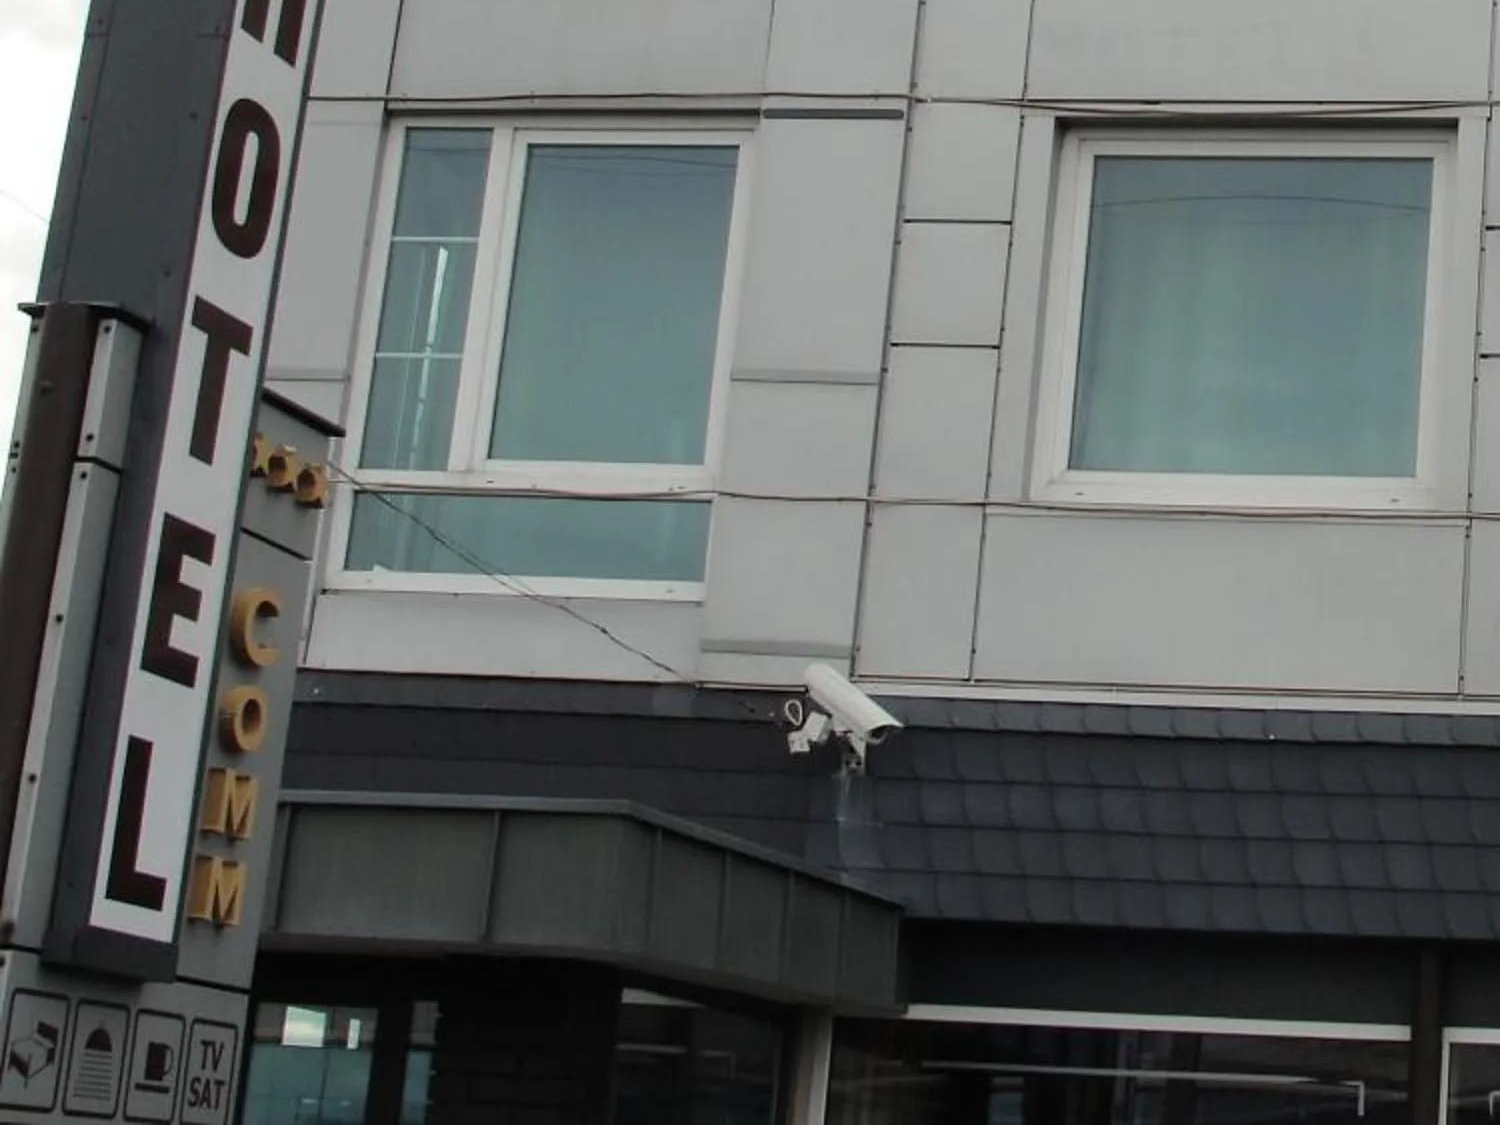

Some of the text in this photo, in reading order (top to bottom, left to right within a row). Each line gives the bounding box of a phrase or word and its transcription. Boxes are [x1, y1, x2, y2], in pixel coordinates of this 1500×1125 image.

[187, 586, 284, 930] COMM
[201, 1040, 225, 1072] TV
[187, 1077, 225, 1110] SAT
